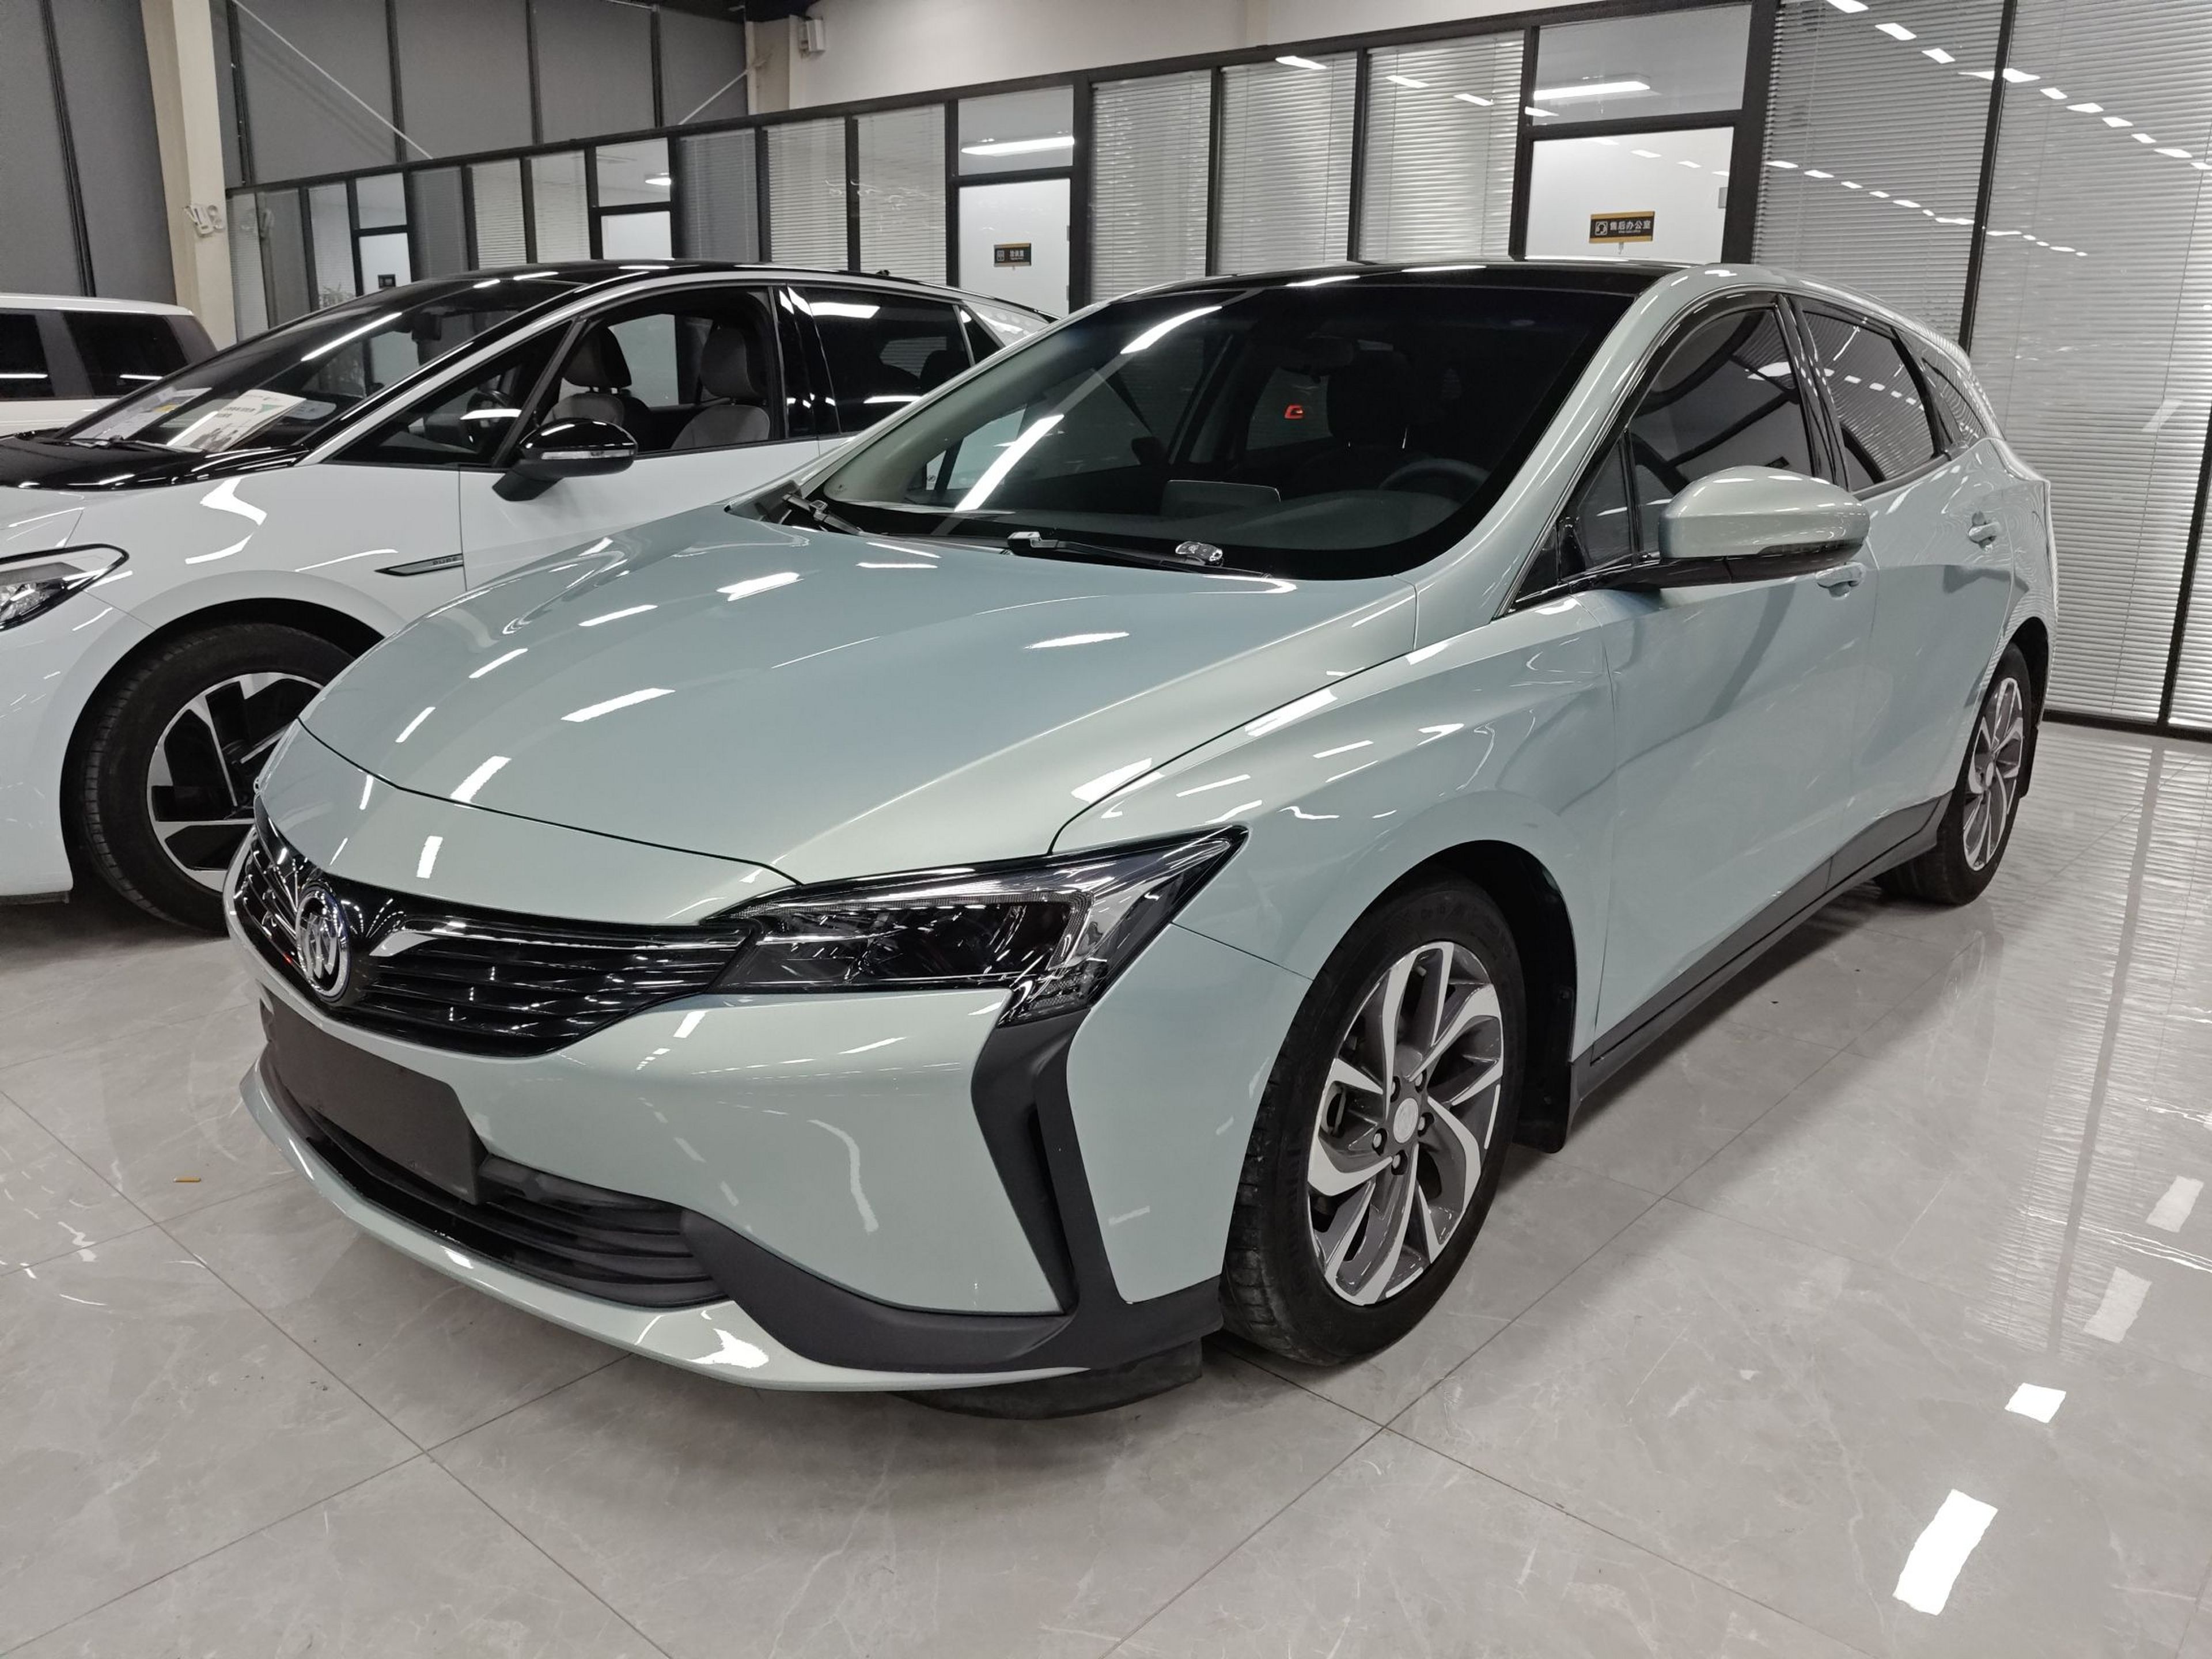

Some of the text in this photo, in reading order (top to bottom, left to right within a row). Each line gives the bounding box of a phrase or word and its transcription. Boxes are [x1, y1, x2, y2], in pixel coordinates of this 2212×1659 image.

[1610, 220, 1651, 230] 售后办公室
